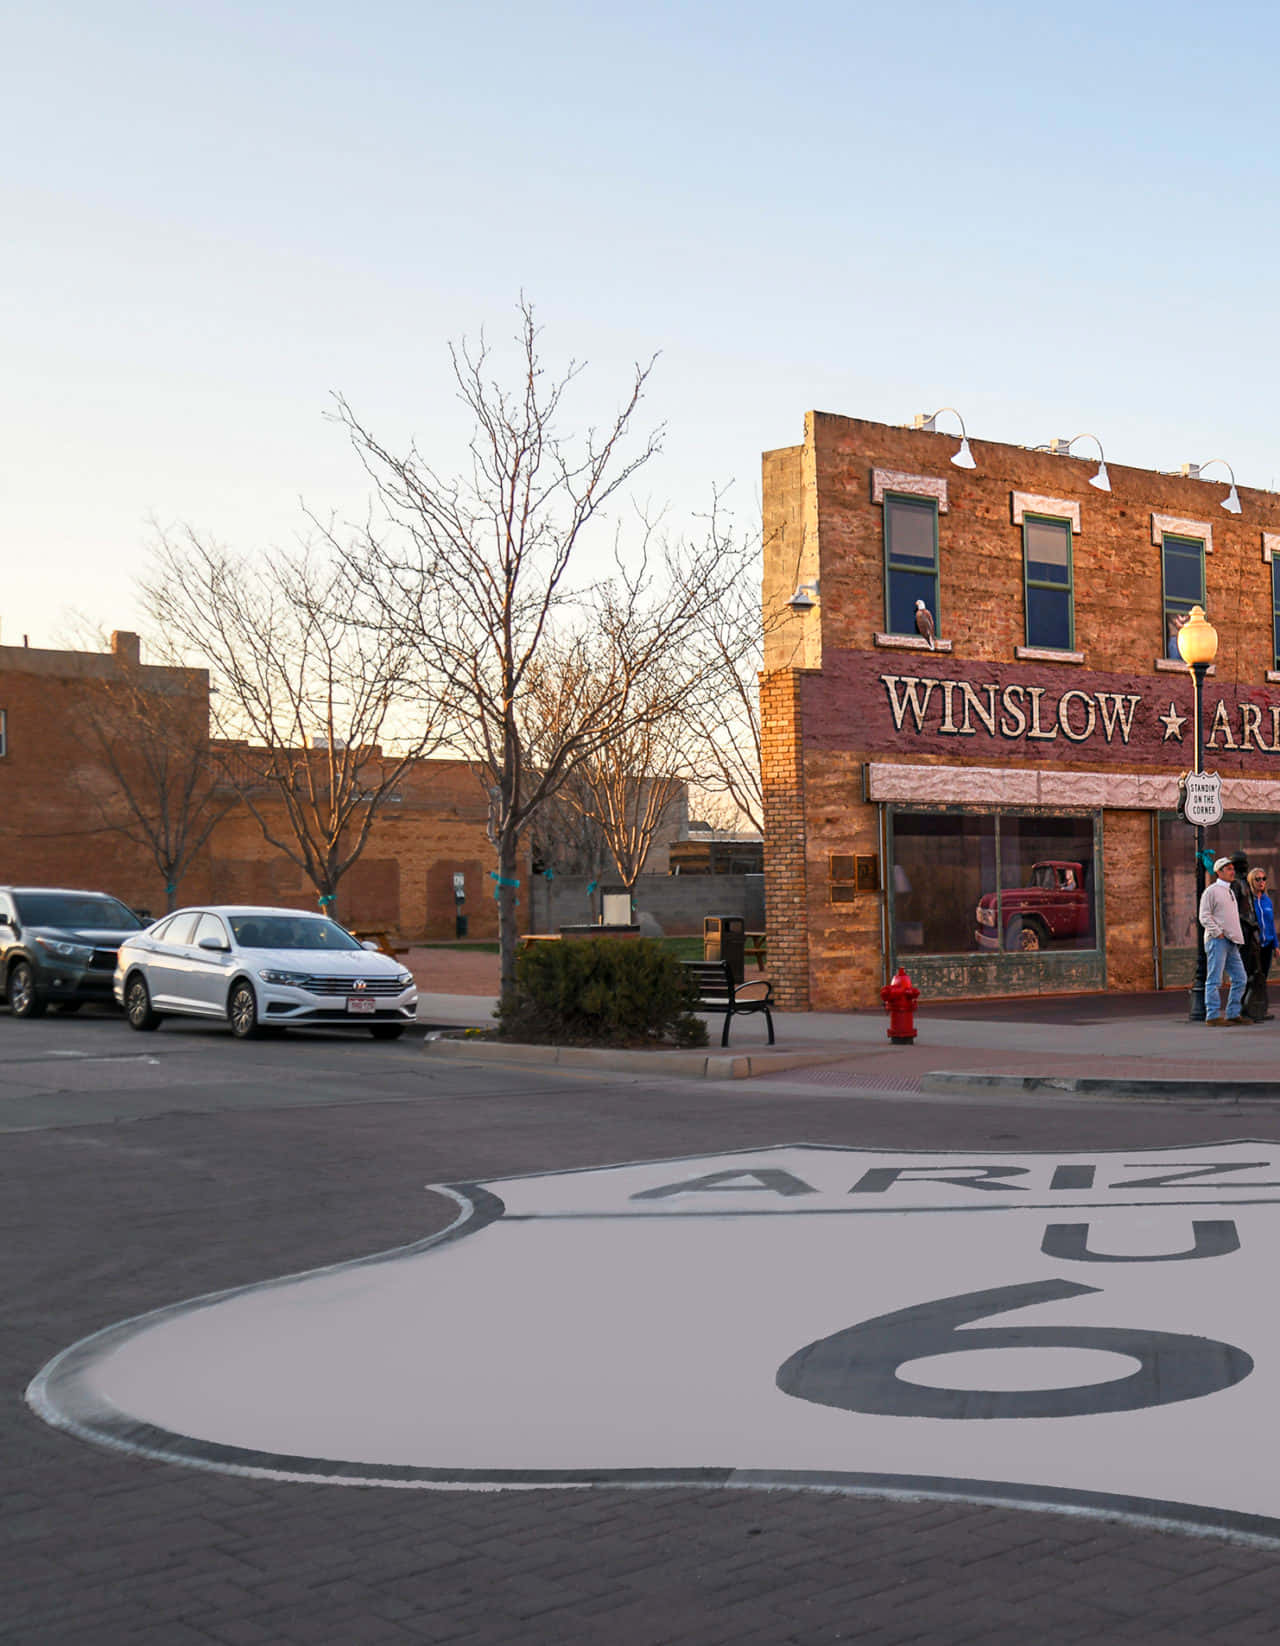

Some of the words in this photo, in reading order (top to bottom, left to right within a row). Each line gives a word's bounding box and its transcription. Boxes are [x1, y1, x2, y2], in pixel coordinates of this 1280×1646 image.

[880, 674, 1142, 744] WINSLOW
[1190, 783, 1218, 793] STANDIN'
[1193, 795, 1202, 804] ON
[1203, 795, 1215, 804] THE
[1192, 806, 1216, 815] CORNER
